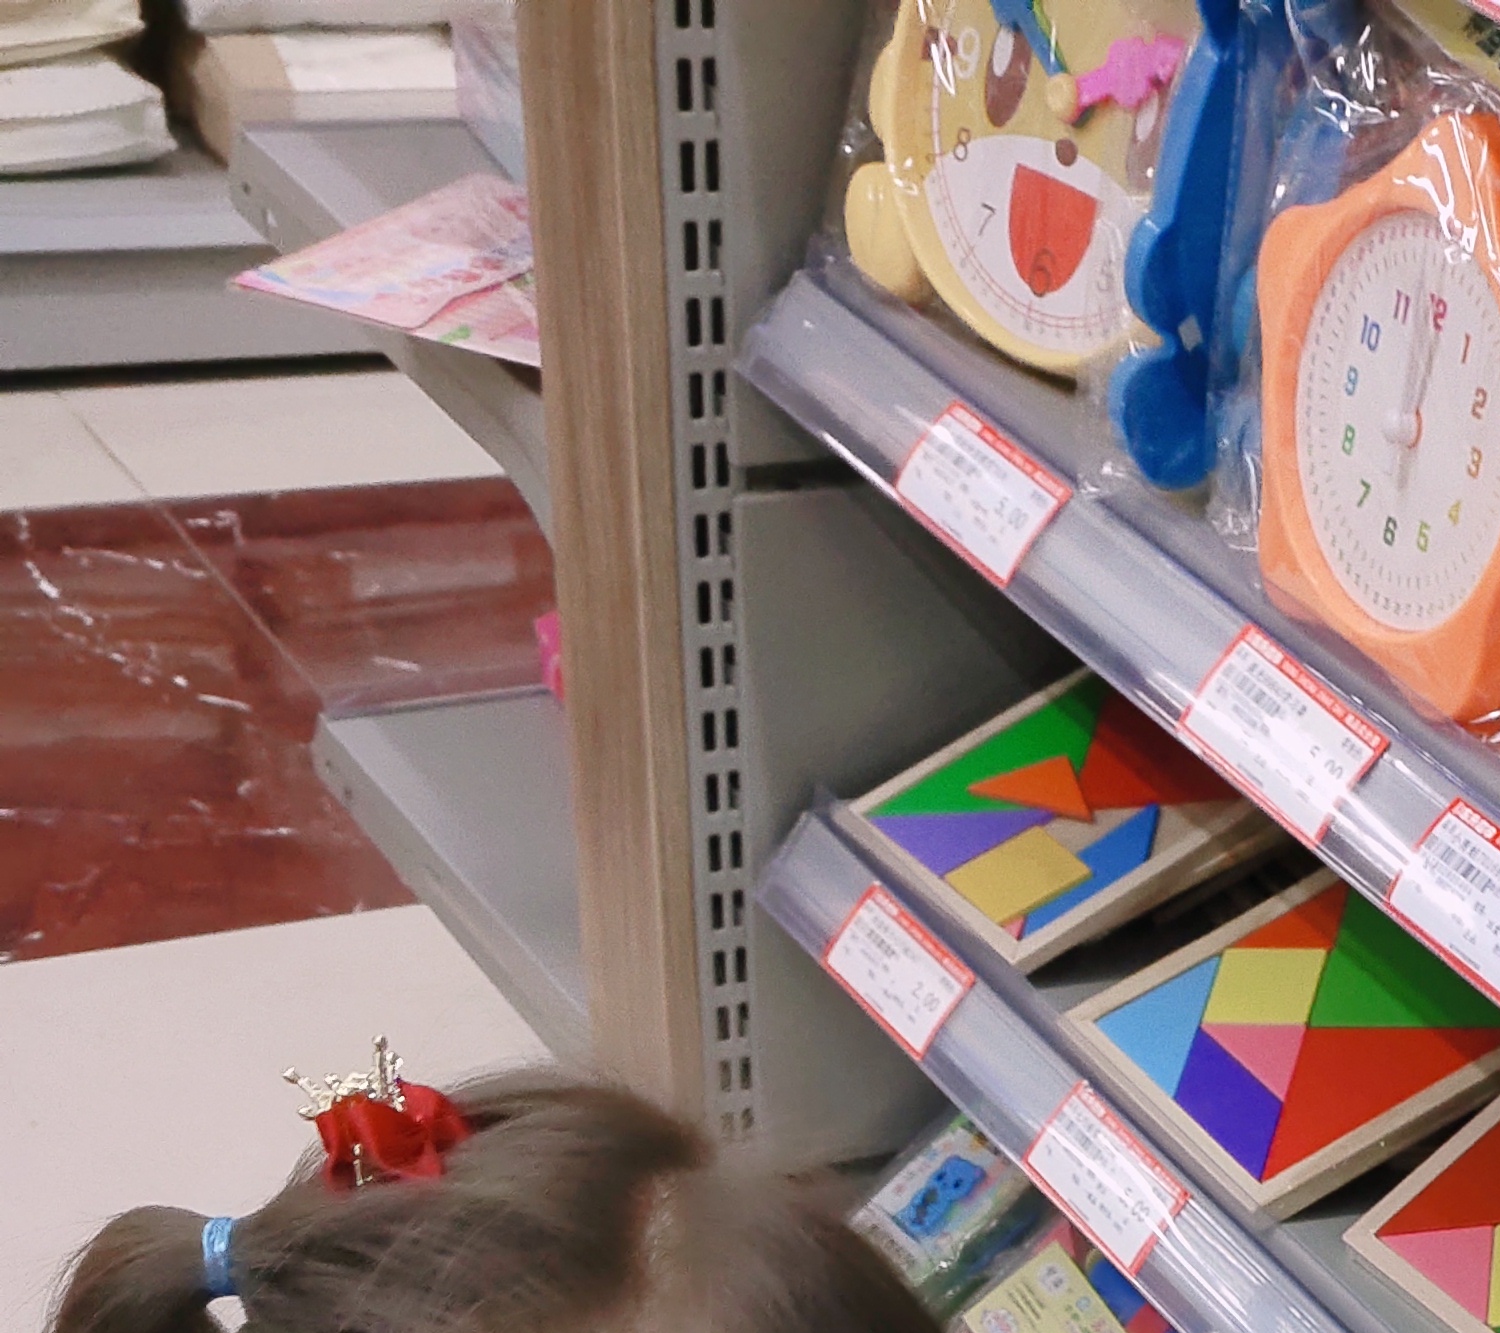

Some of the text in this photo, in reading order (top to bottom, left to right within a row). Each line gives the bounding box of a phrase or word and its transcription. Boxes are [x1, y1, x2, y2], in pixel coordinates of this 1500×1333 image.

[953, 128, 971, 162] 8
[978, 202, 996, 236] 7
[1394, 289, 1410, 325] 11
[1361, 314, 1381, 351] 10
[1461, 333, 1471, 364] 1
[1345, 366, 1358, 396] 9
[1471, 387, 1488, 420] 2
[1342, 424, 1356, 456] 8
[1467, 446, 1482, 478] 3
[1357, 478, 1371, 508] 7
[1448, 500, 1462, 526] 4
[1383, 515, 1397, 547] 6
[1417, 520, 1431, 552] 5
